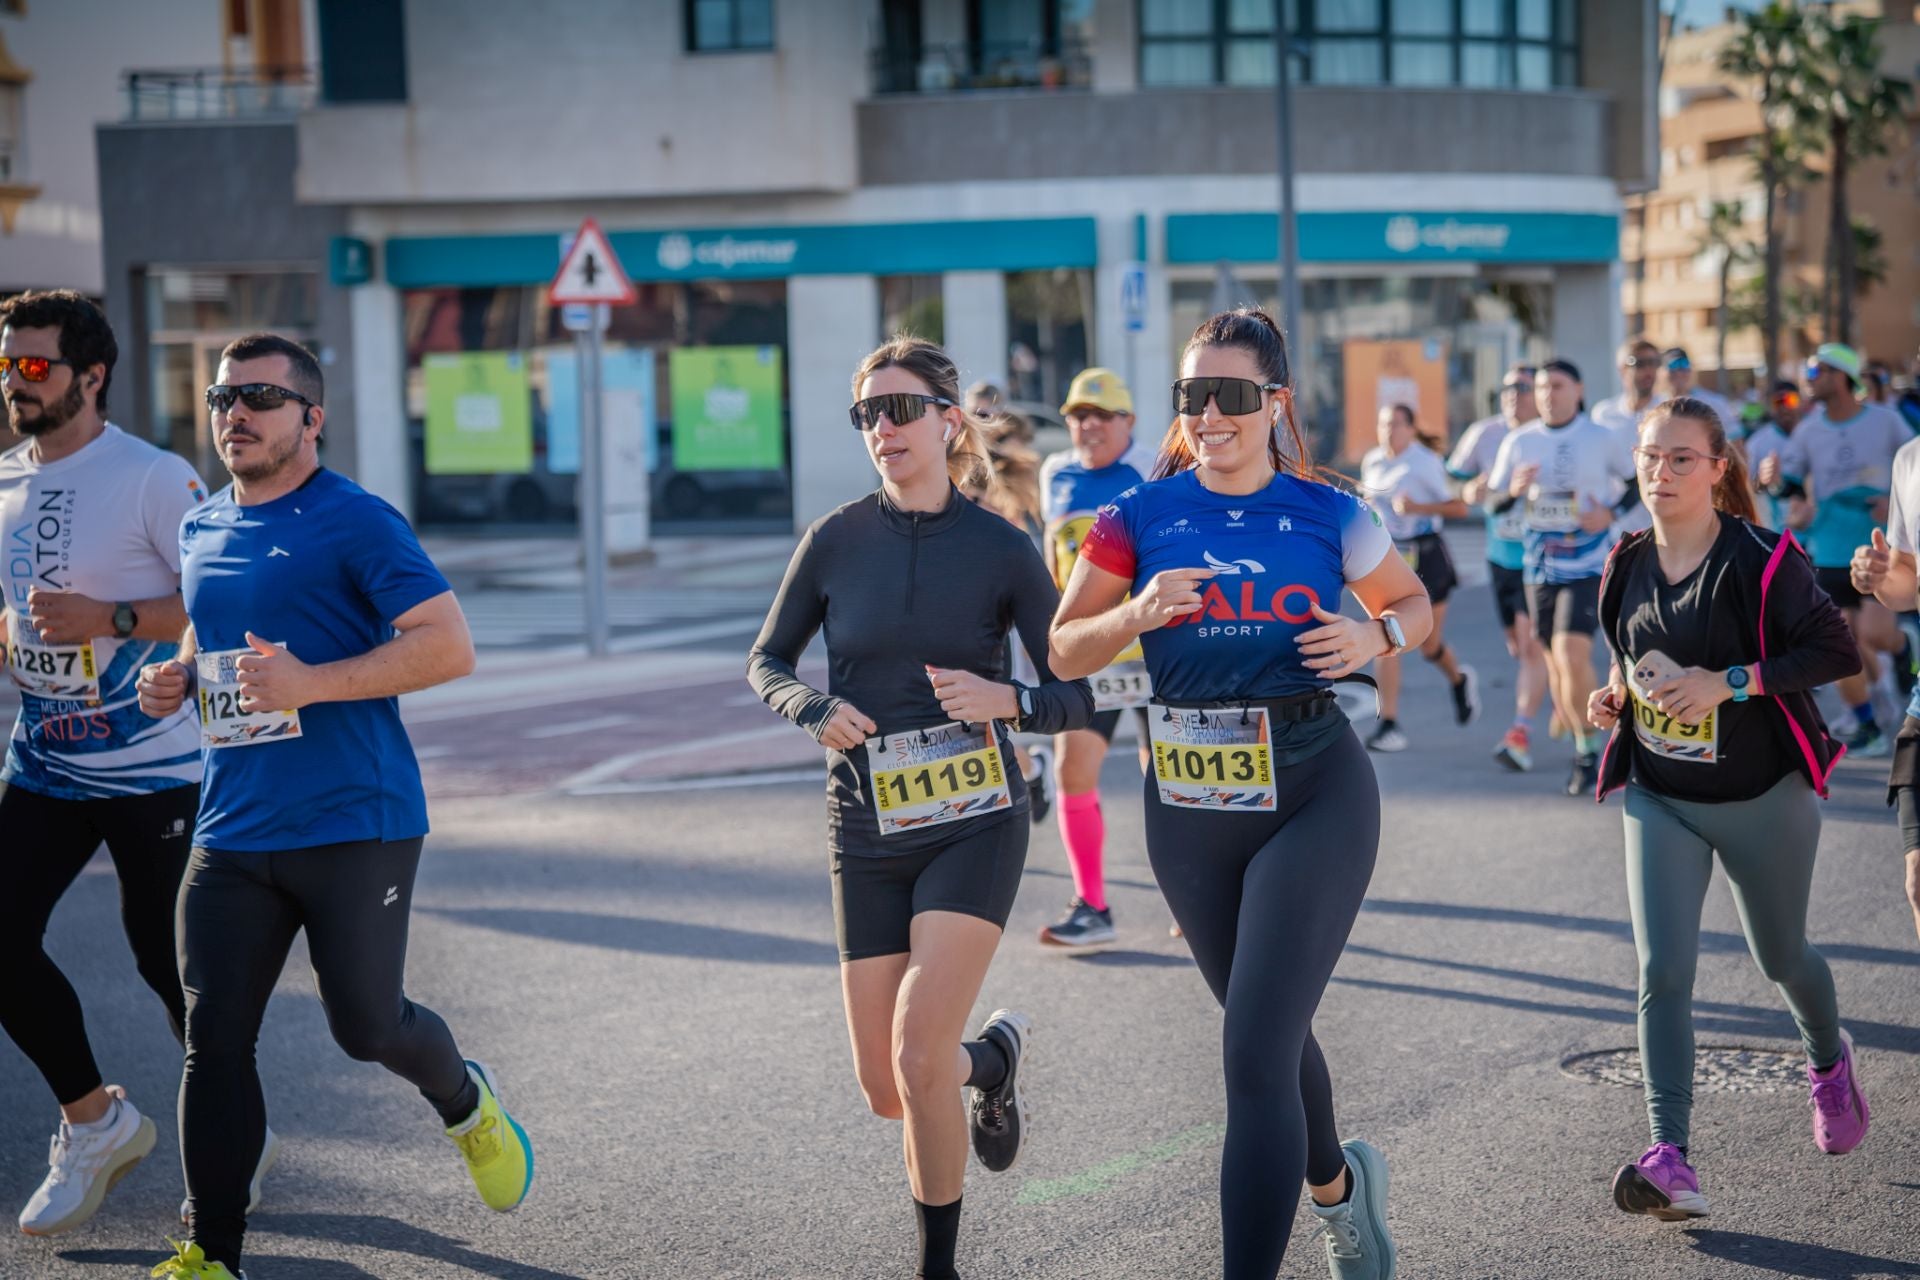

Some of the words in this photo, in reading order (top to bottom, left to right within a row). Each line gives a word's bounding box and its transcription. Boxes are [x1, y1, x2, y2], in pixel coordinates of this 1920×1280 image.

[36, 490, 64, 590] ATON
[61, 489, 76, 571] ROQUETAS
[1158, 525, 1201, 537] SPIRAL
[10, 522, 33, 618] EDIA
[1162, 581, 1320, 628] ALO
[1198, 625, 1264, 637] SPORT
[13, 644, 78, 677] 1287
[41, 701, 81, 713] MEDIA
[208, 690, 276, 720] 128
[42, 713, 111, 741] KIDS
[890, 757, 986, 803] 1119
[1166, 748, 1255, 781] 1013
